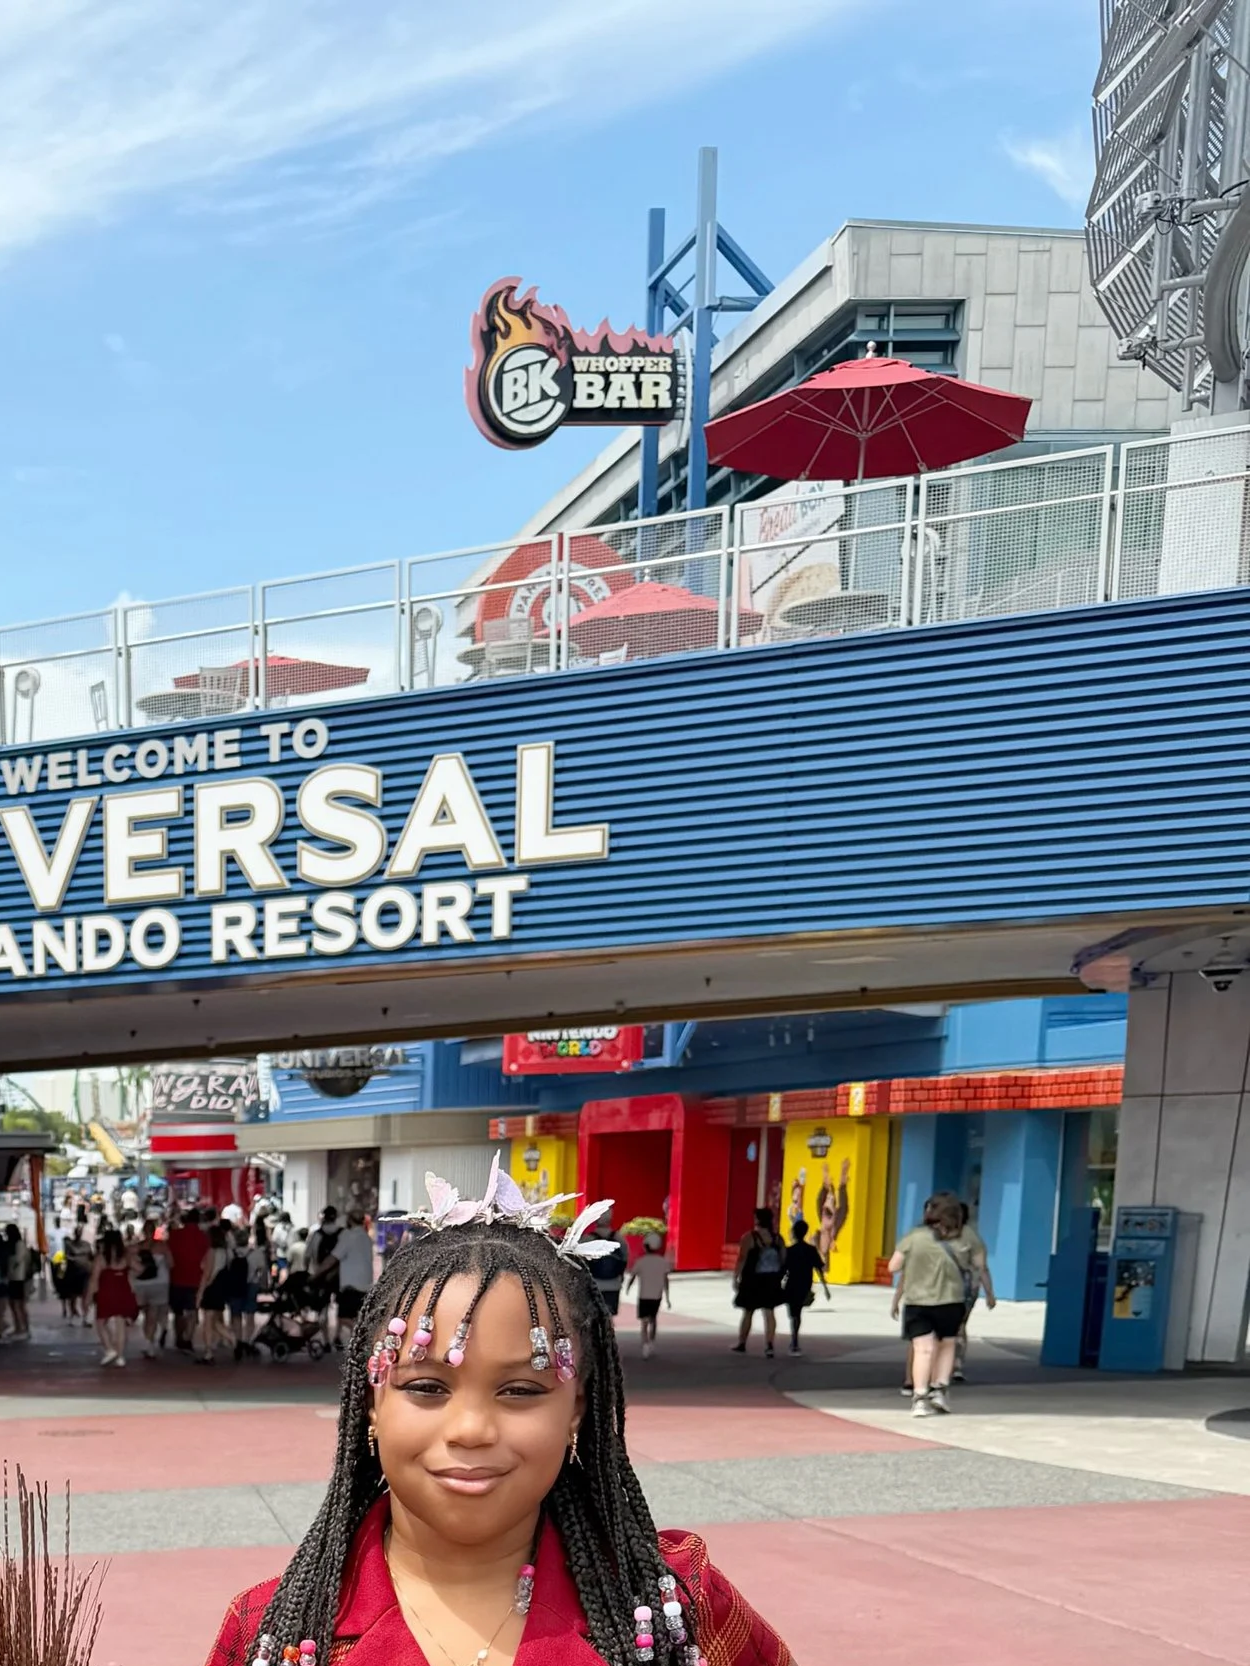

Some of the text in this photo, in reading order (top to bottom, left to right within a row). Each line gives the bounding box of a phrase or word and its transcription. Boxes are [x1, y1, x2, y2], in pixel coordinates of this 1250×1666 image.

[502, 357, 561, 415] BK
[572, 356, 672, 373] WHOPPER
[572, 373, 672, 409] BAR
[0, 718, 330, 795] WELCOME TO
[211, 875, 530, 963] RESORT
[540, 1040, 601, 1058] WORLD
